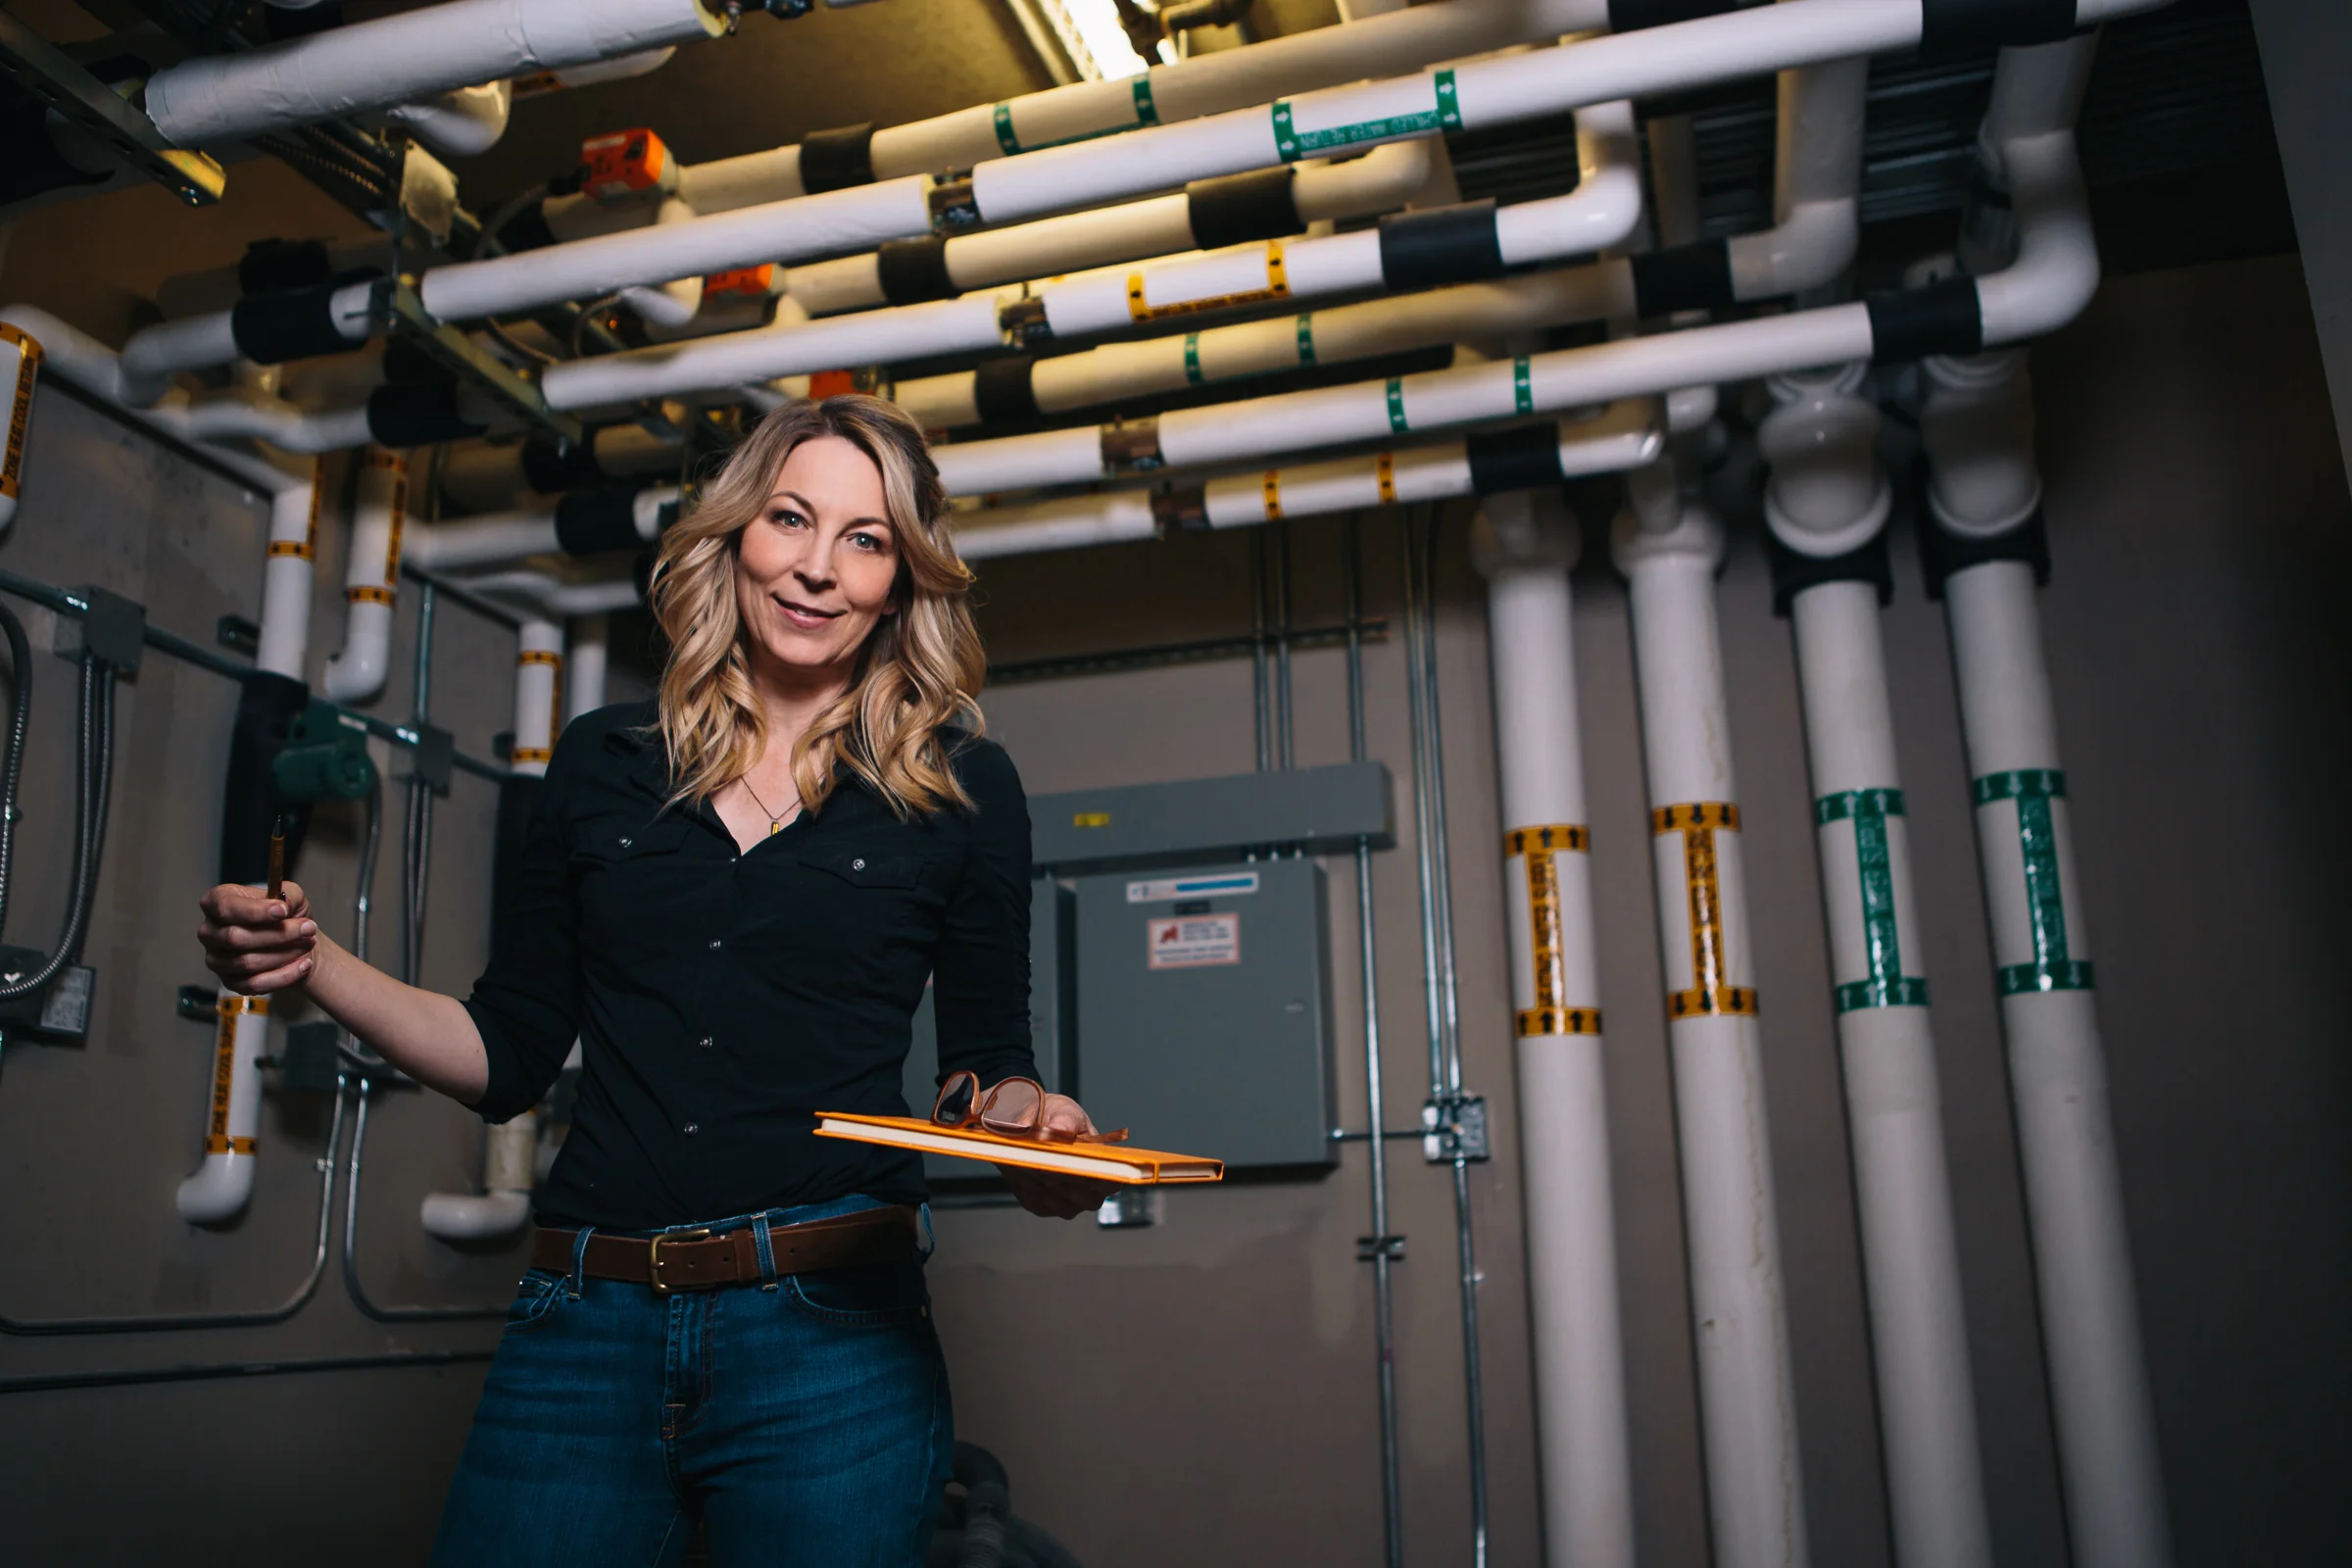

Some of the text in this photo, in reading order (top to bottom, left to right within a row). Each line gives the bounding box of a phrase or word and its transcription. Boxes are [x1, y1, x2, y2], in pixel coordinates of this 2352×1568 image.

[13, 397, 30, 423] COOL
[9, 424, 24, 448] HEAT
[3, 451, 21, 481] ZONE
